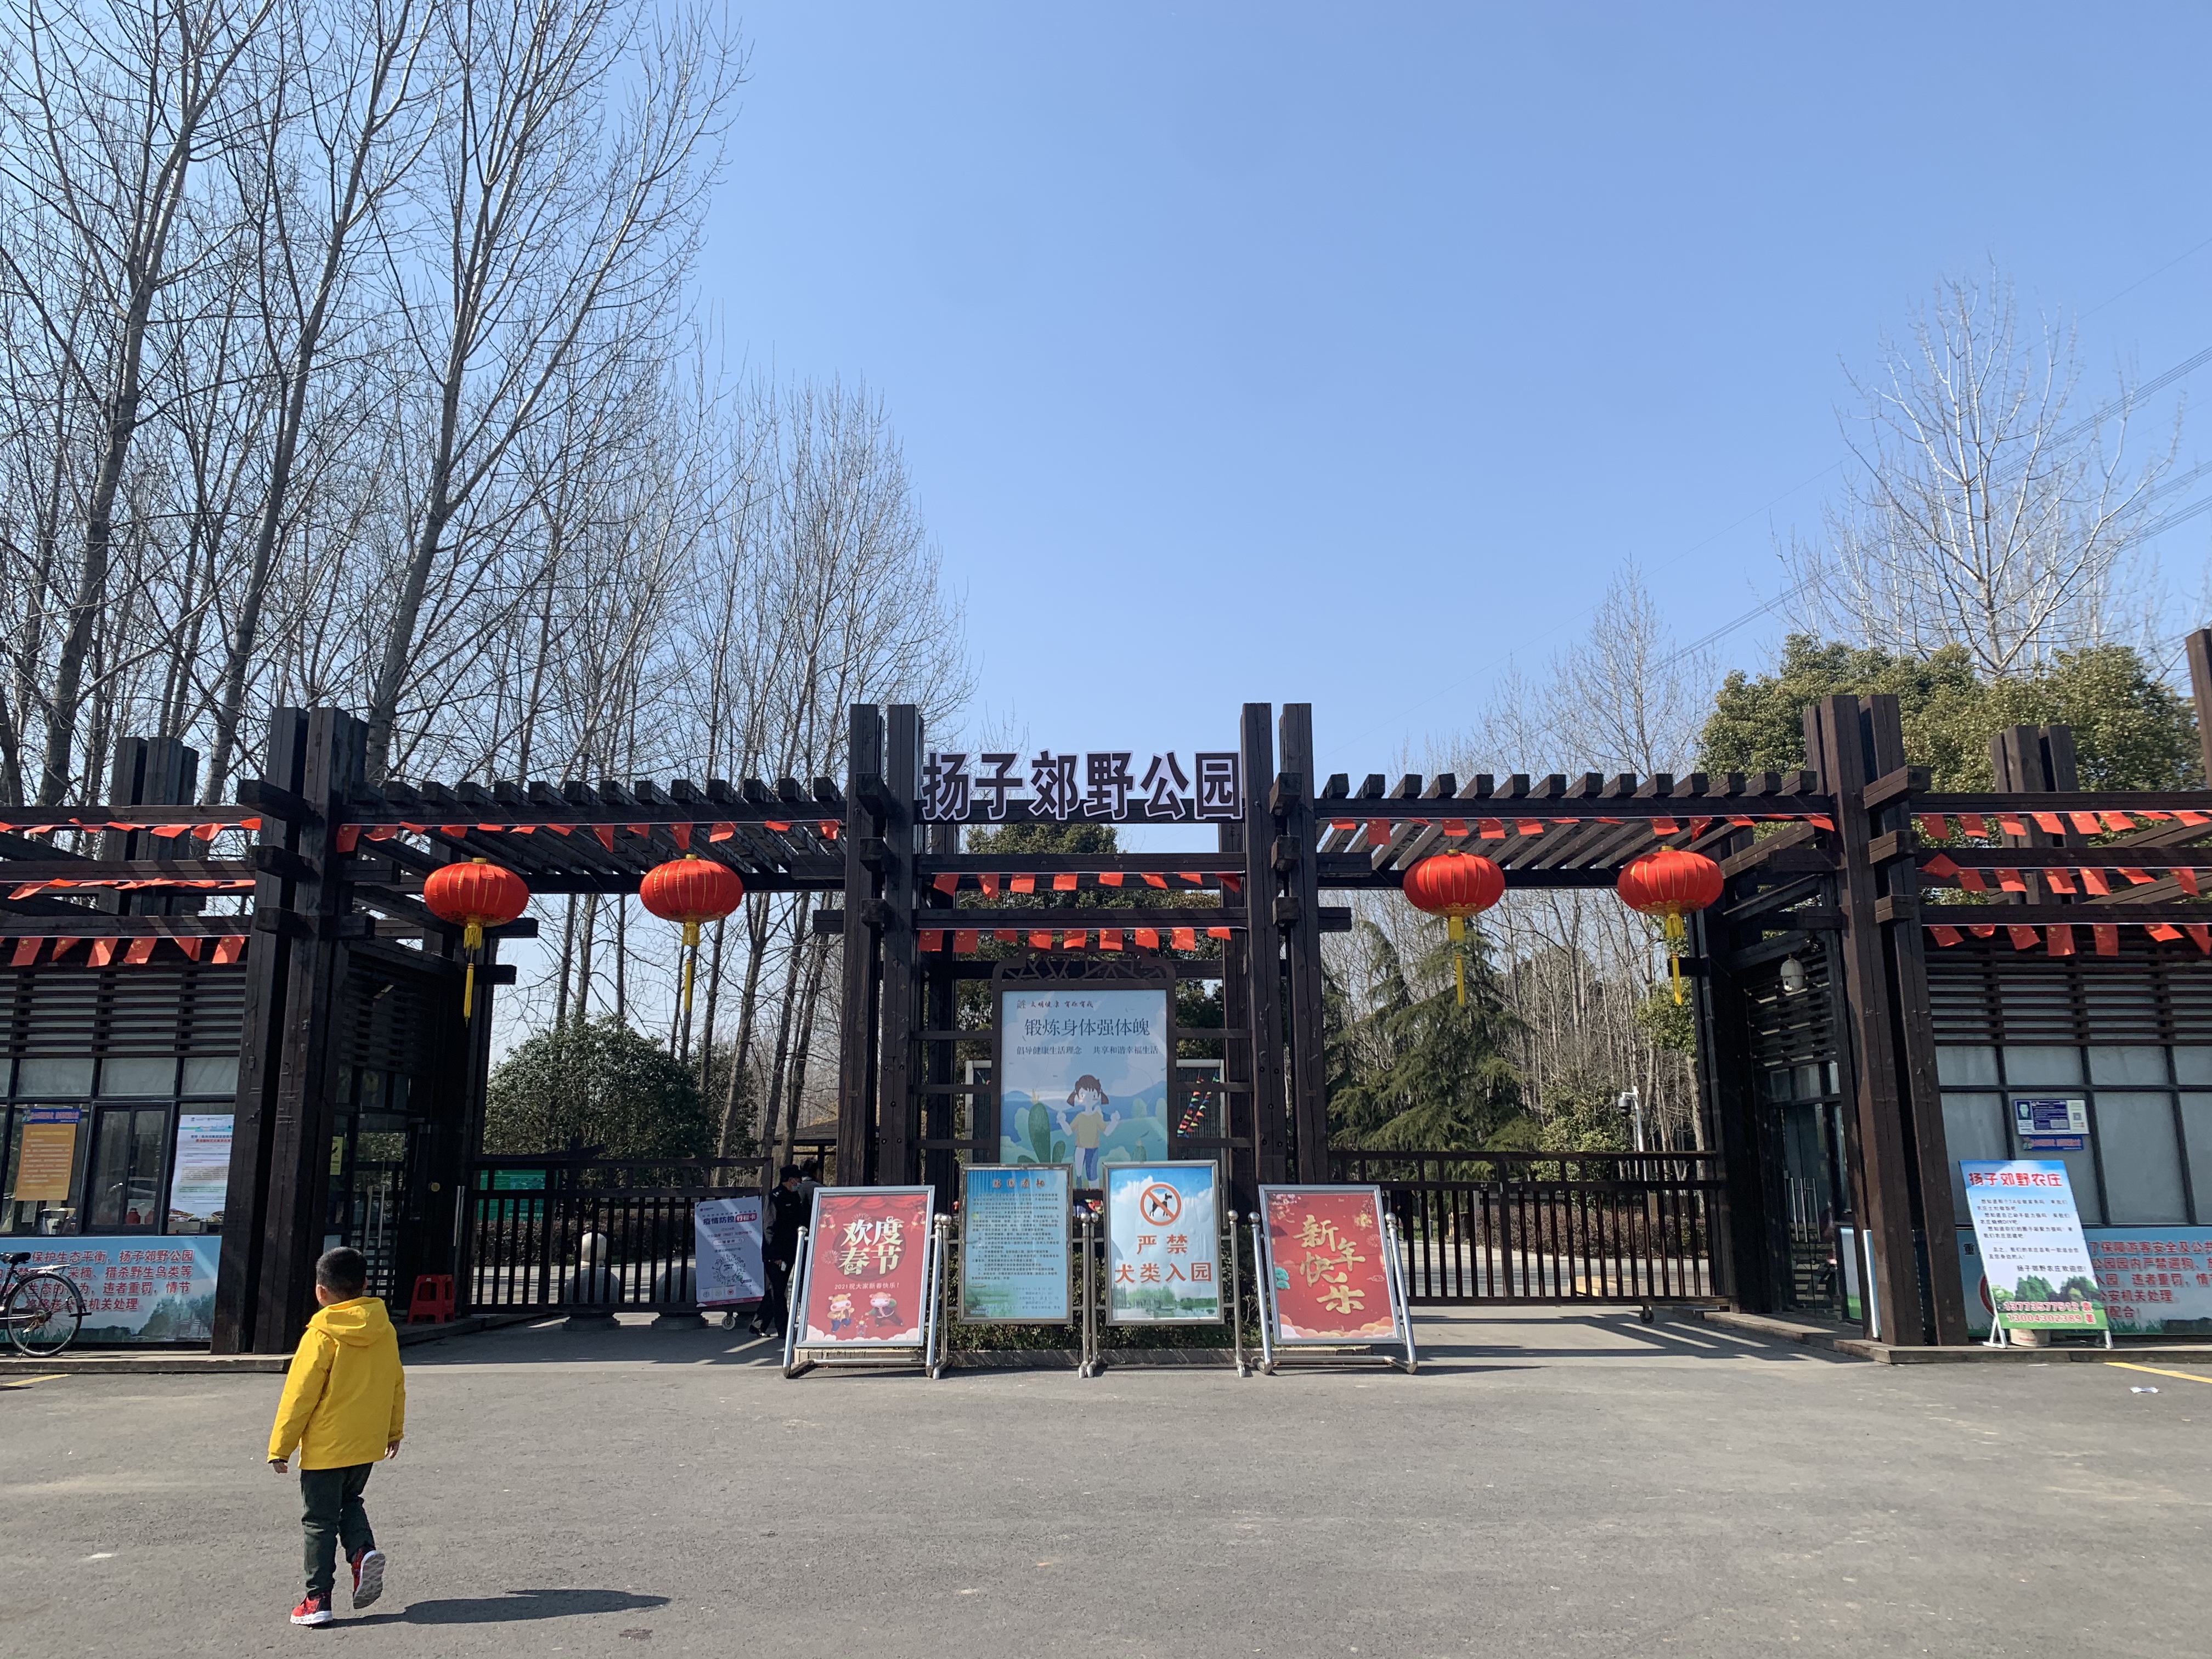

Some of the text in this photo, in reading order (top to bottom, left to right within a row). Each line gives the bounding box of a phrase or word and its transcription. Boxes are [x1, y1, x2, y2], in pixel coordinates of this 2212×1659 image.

[922, 749, 1242, 820] 扬子郊野公园
[1024, 1018, 1150, 1036] 锻炼身体强体魄
[1017, 1046, 1159, 1055] 倡导健康生活理念 共享和谐幸福生活
[1968, 1172, 2063, 1187] 扬子郊野农庄
[840, 1216, 905, 1247] 欢度
[1136, 1233, 1188, 1255] 严禁
[1292, 1214, 1366, 1272] 新年
[838, 1245, 902, 1276] 春节
[1114, 1262, 1212, 1284] 犬类入园
[1299, 1251, 1365, 1314] 快乐
